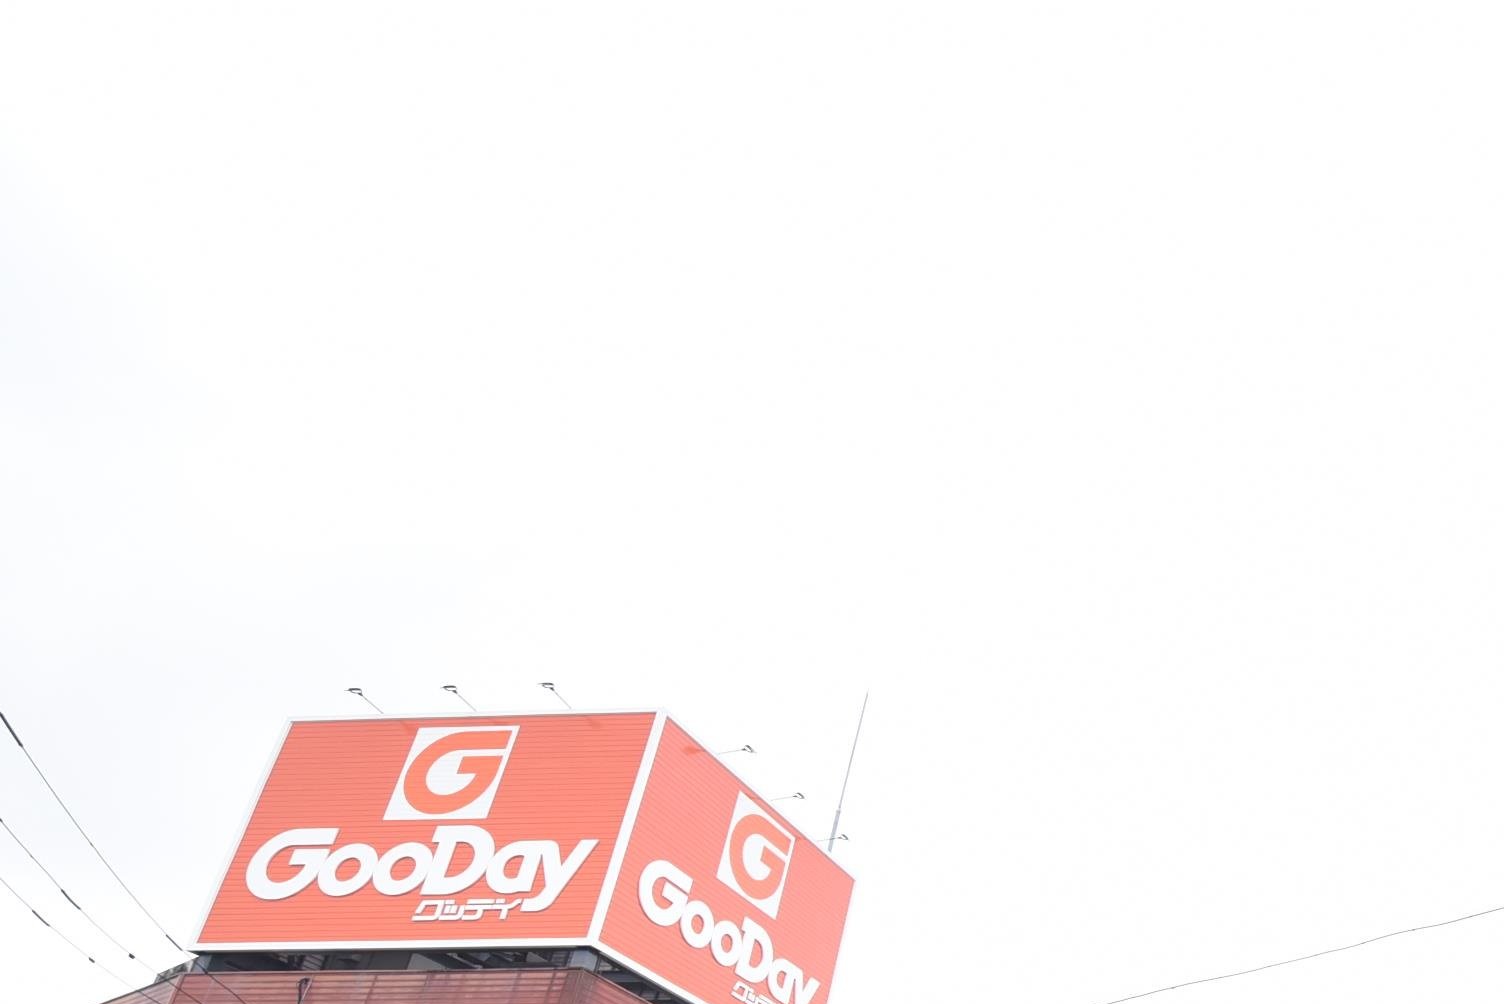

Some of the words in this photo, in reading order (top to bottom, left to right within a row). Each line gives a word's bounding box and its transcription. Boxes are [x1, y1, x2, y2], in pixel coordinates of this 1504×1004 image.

[245, 824, 600, 912] GooDay
[412, 898, 525, 921] グッデイ
